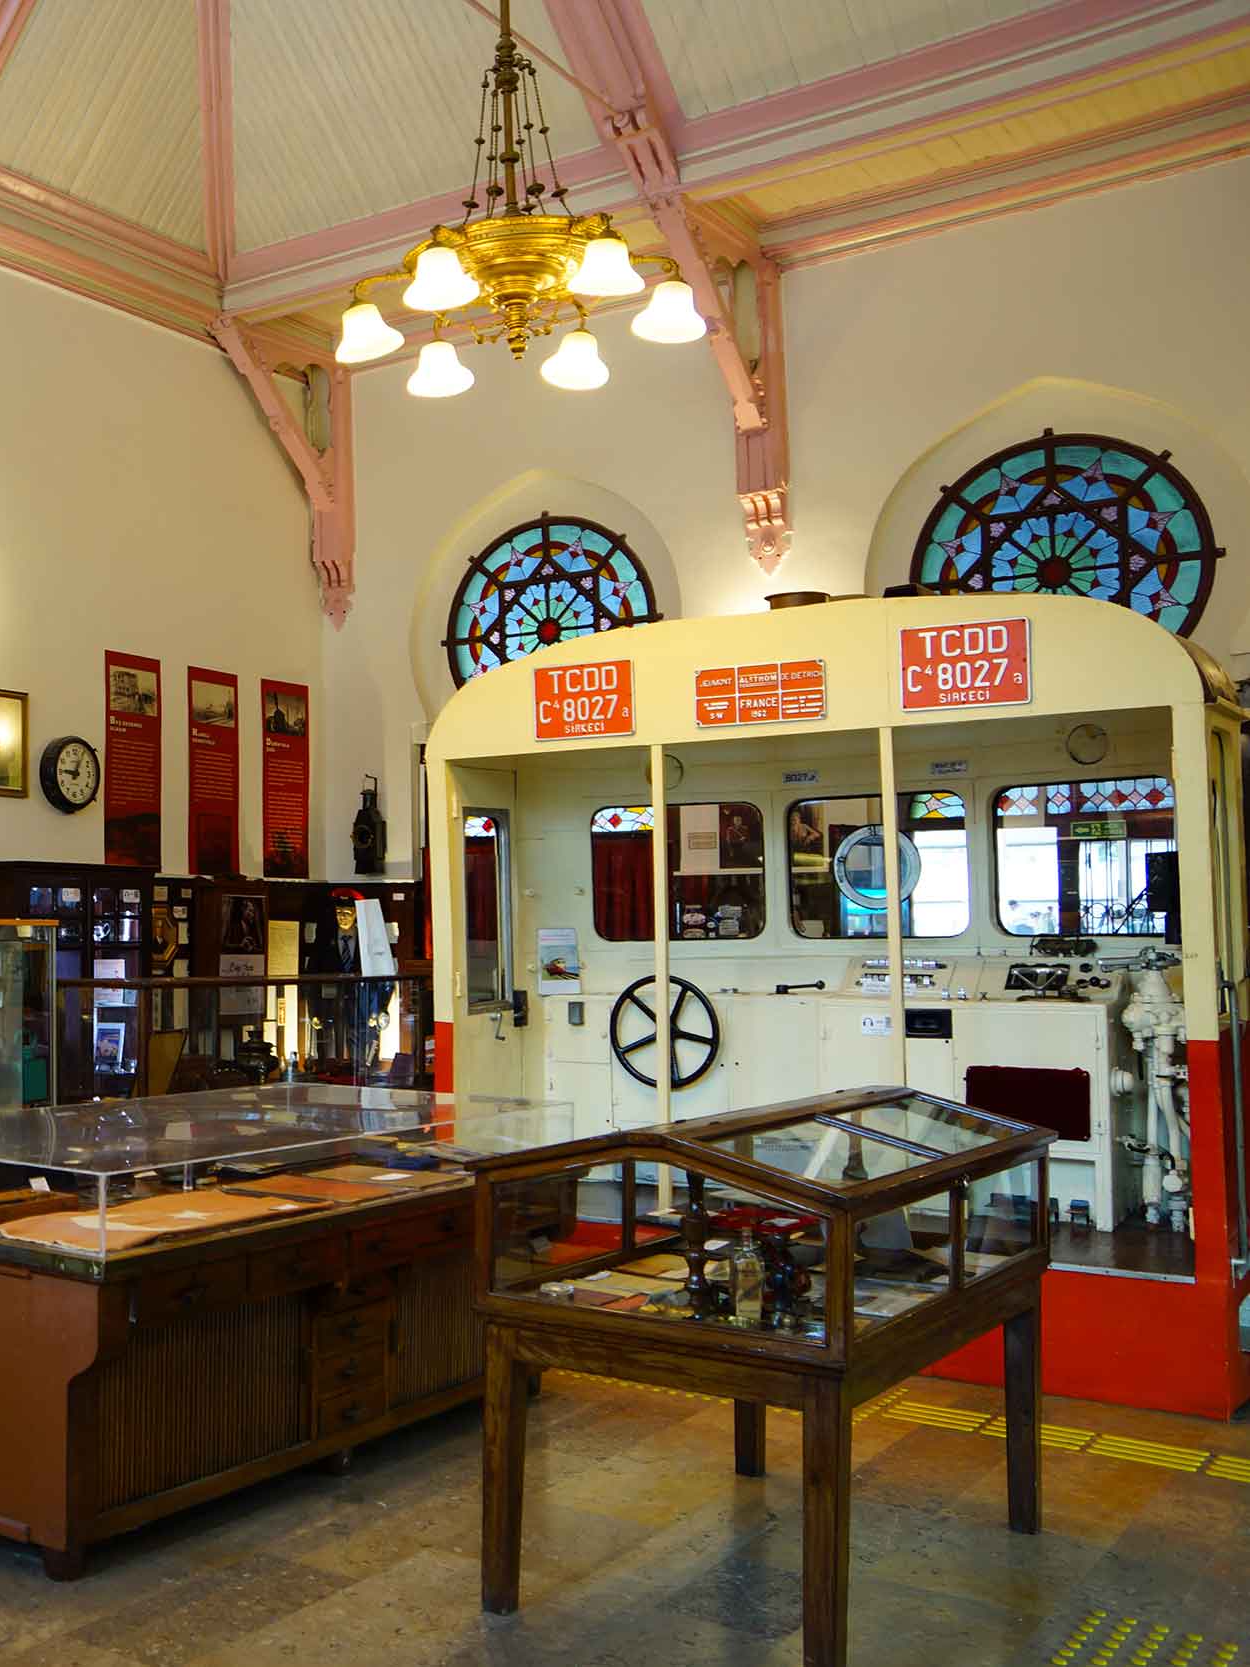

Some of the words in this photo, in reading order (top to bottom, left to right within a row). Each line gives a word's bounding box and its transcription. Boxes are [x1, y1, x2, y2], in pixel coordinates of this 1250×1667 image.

[918, 625, 1008, 659] TCDD
[547, 665, 618, 694] TCDD
[740, 697, 778, 708] FRANCE
